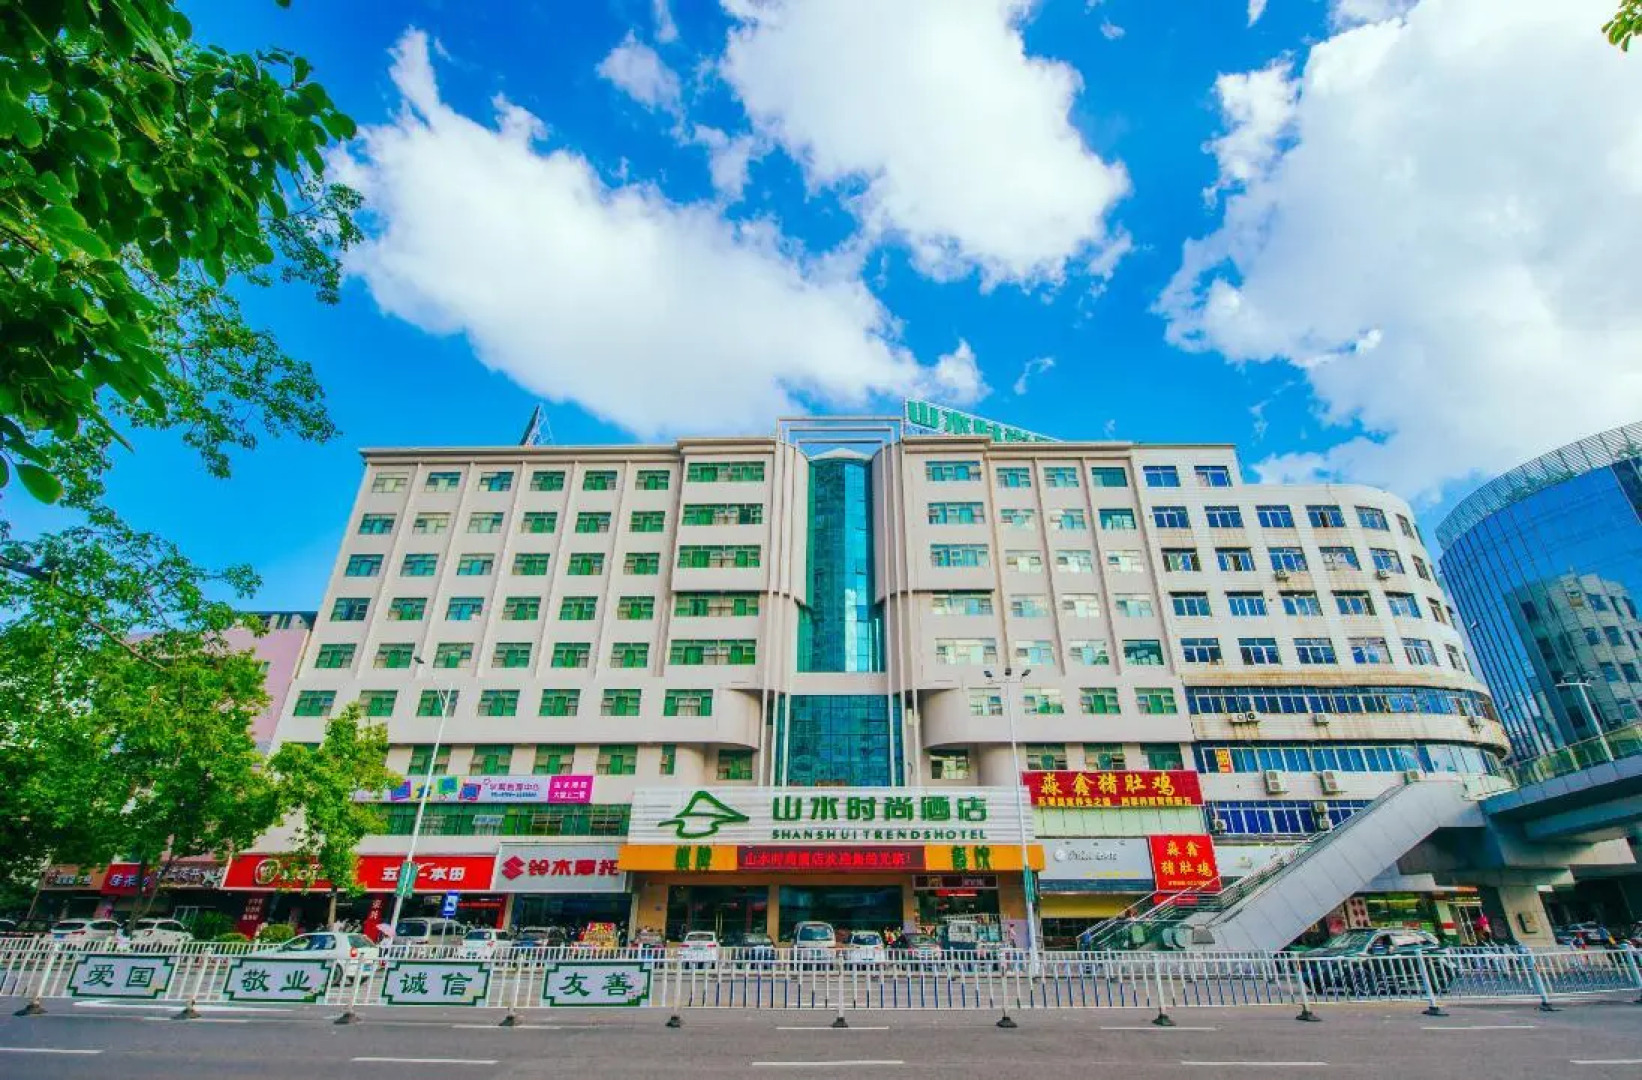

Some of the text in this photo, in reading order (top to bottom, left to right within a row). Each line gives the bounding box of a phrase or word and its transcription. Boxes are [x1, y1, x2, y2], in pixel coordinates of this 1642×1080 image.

[772, 796, 988, 822] 山水时尚酒店
[772, 829, 857, 840] SHANSHUI
[528, 859, 620, 876] 铃木摩托
[83, 964, 155, 988] 爱国
[241, 965, 314, 992] 敬业
[399, 972, 473, 996] 诚信
[558, 972, 634, 997] 友善
